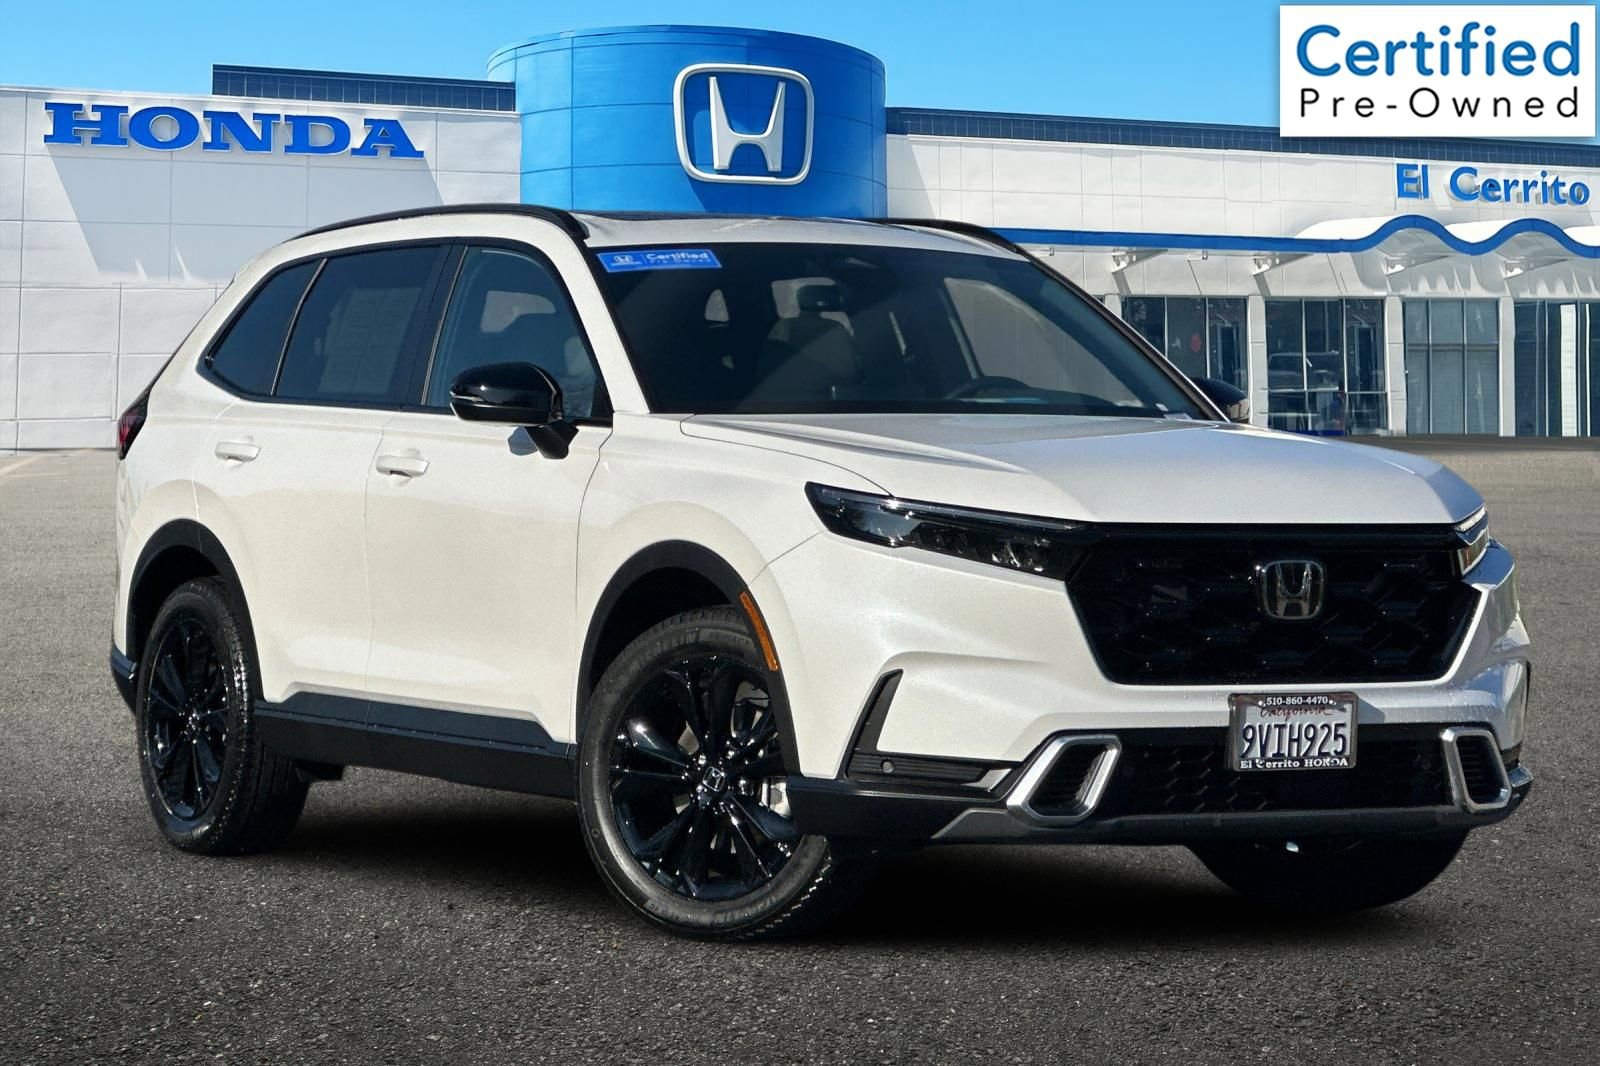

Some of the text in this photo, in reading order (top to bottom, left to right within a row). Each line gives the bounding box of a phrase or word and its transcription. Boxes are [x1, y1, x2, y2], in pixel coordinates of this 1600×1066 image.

[43, 101, 425, 159] HONDA
[1395, 162, 1591, 205] El Cerrito
[646, 252, 708, 260] Certified
[1266, 696, 1328, 706] 510-860-4470
[1240, 723, 1347, 758] 9VIH925
[1240, 757, 1348, 769] El Cerrito HONDA
